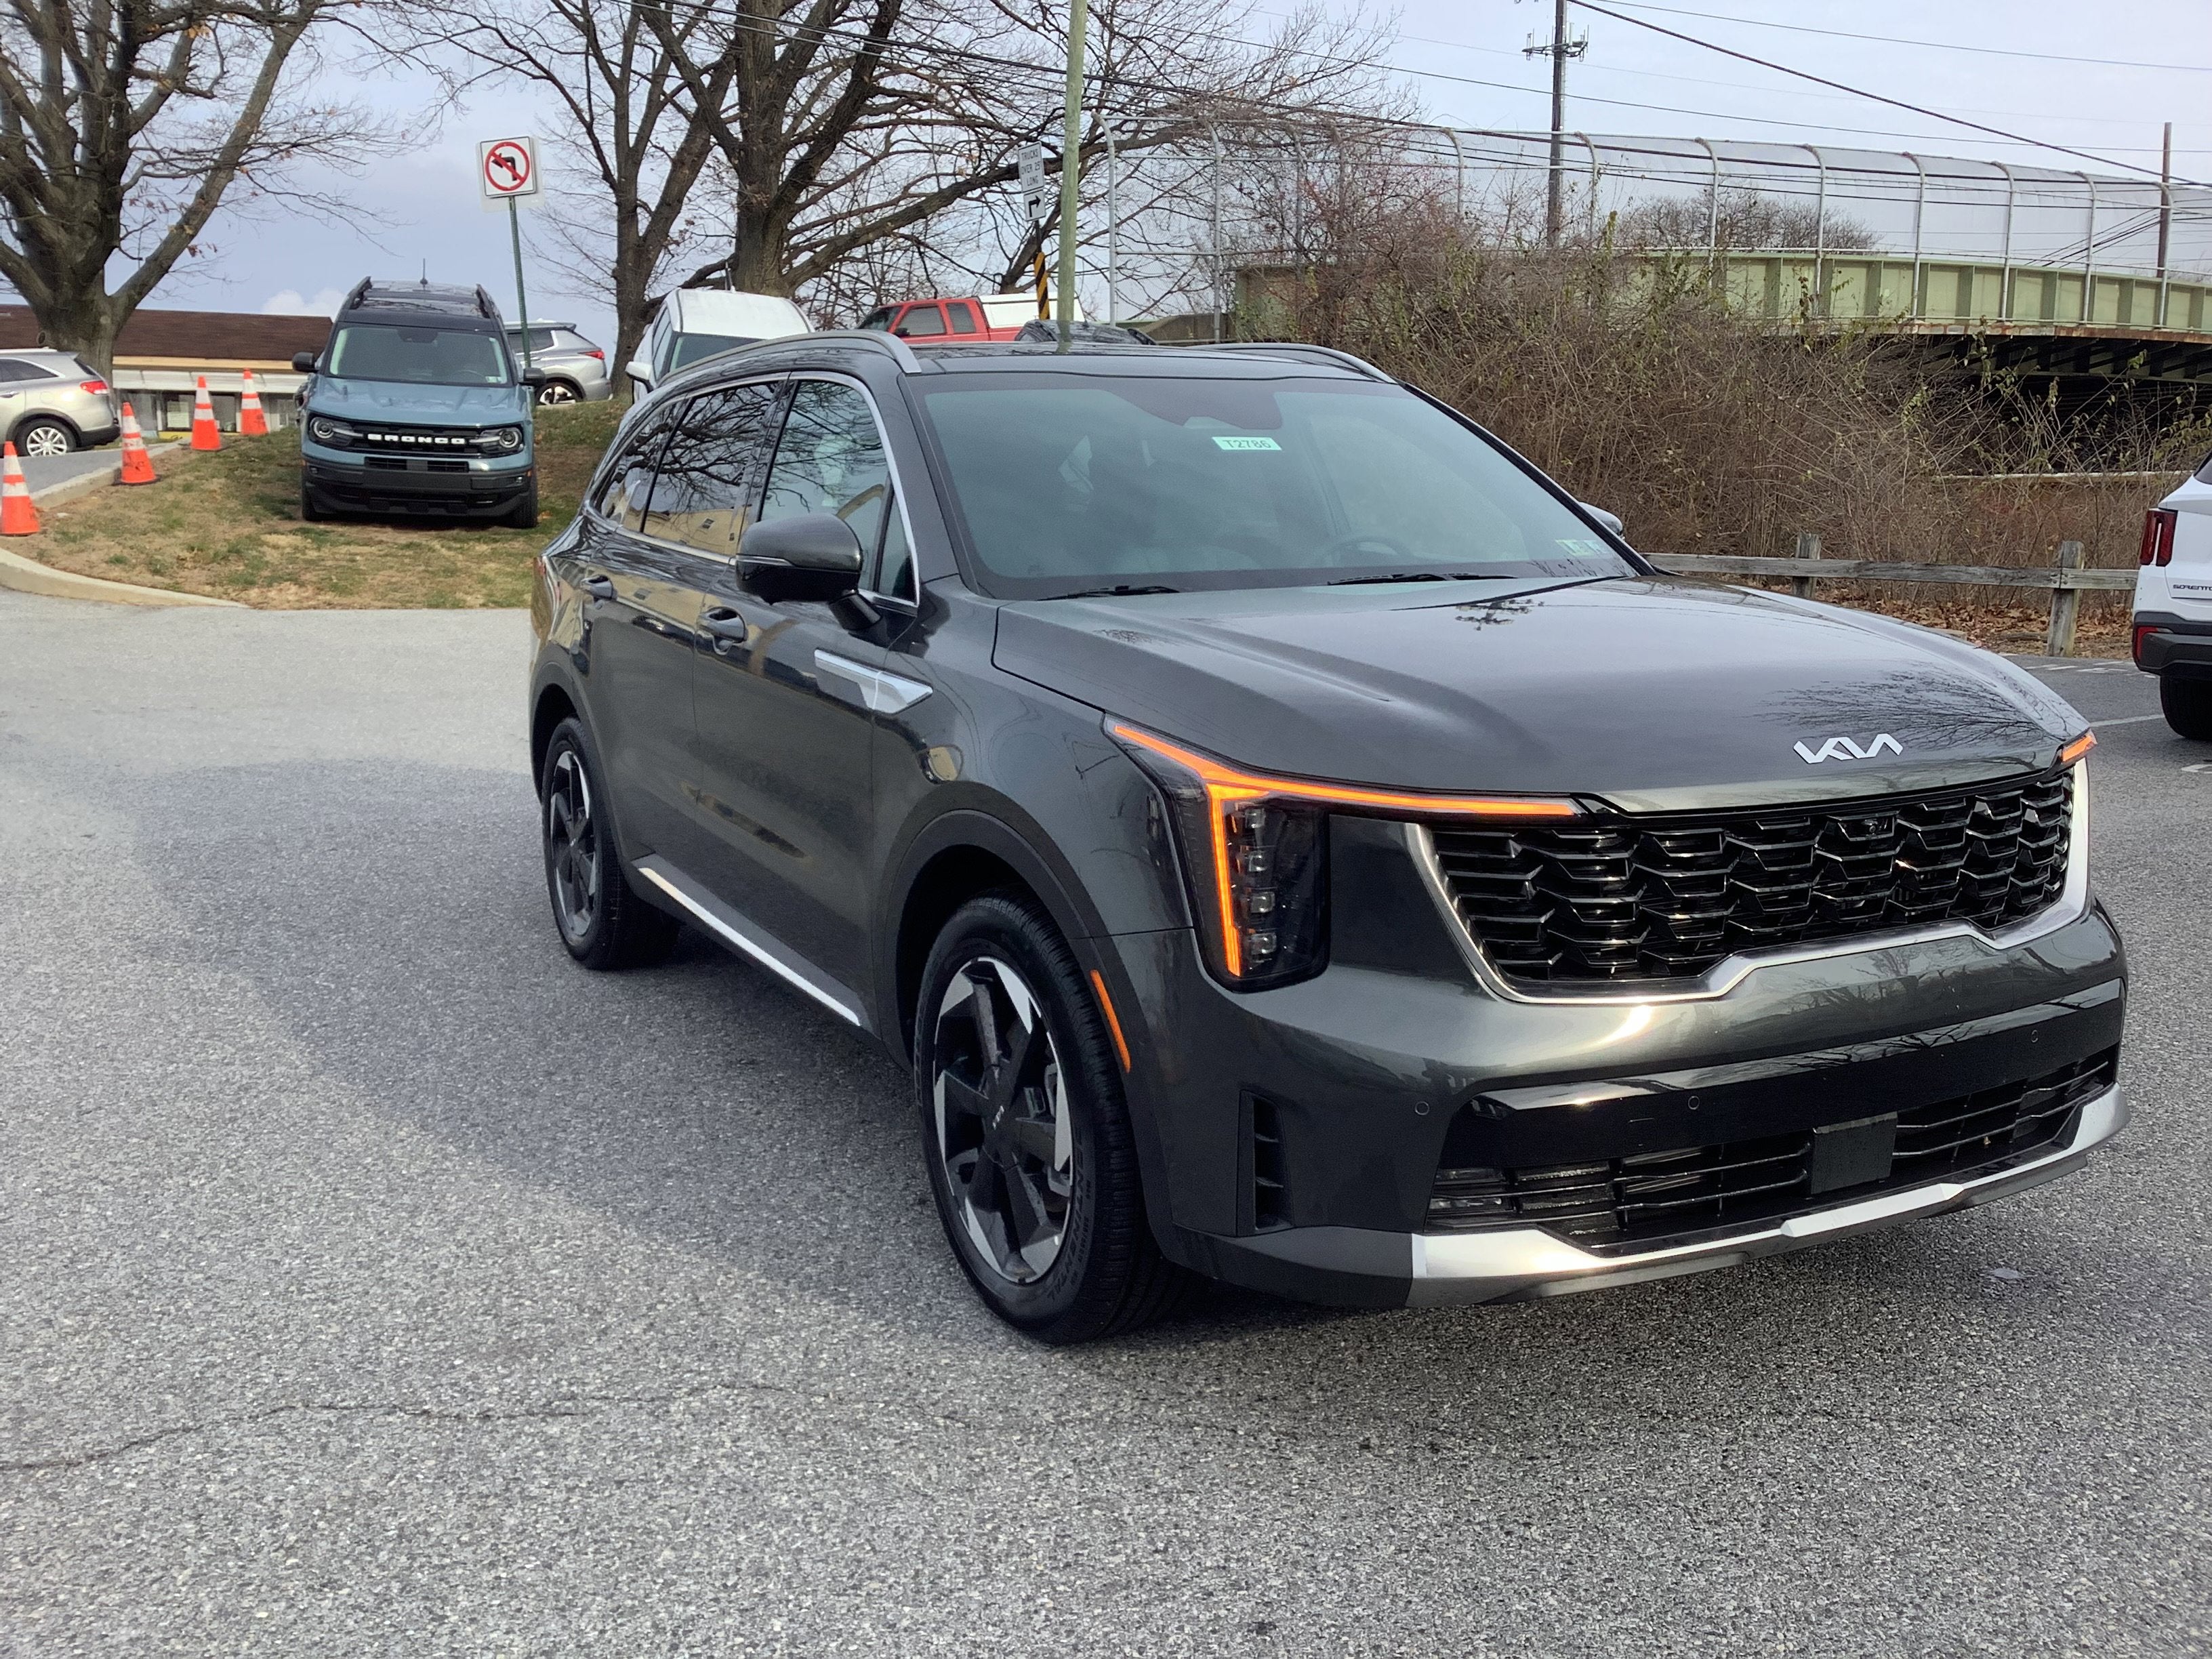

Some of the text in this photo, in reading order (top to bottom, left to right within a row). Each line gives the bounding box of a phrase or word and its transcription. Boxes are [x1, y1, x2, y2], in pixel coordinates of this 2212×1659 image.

[1021, 149, 1038, 161] TRUCKS
[367, 433, 465, 445] BRONCO
[1223, 439, 1271, 449] T2786
[1793, 733, 1904, 764] KIA
